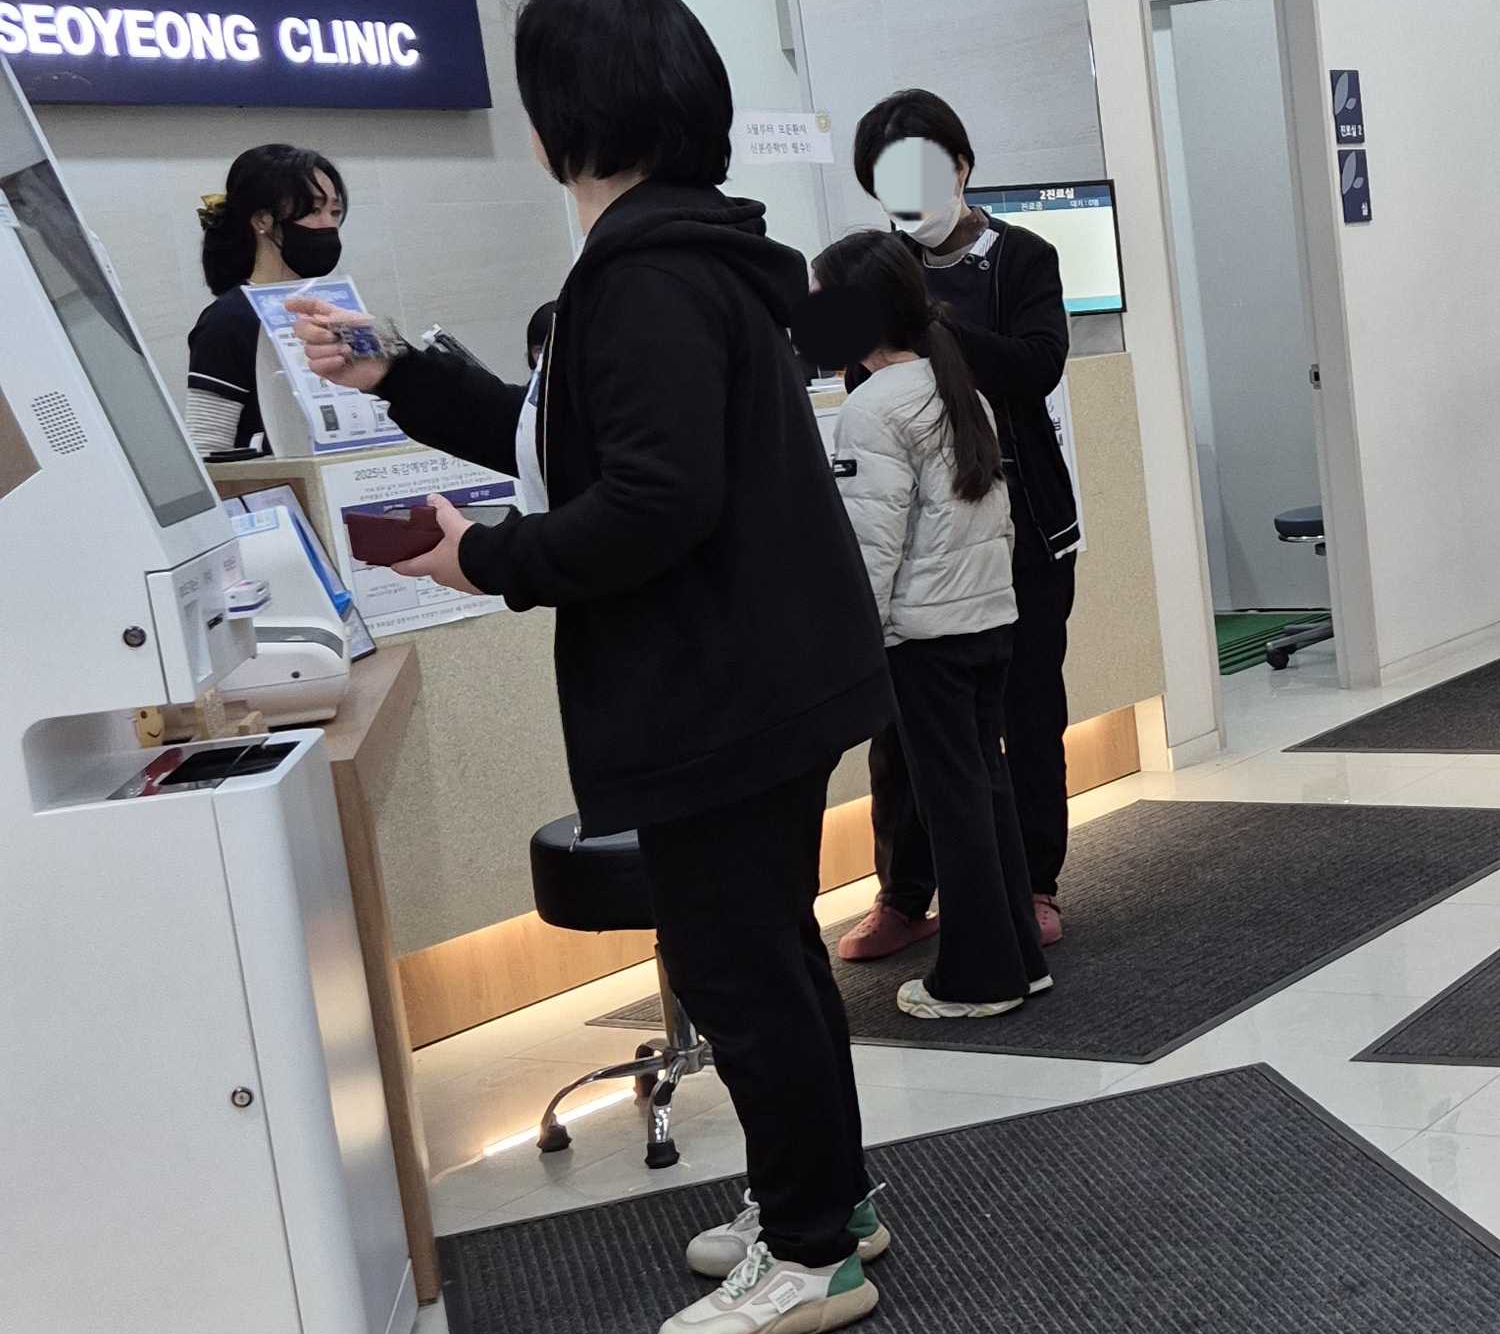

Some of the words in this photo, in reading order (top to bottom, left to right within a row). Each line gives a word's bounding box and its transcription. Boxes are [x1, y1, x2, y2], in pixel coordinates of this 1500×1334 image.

[0, 0, 260, 62] SEOYEONG
[279, 17, 421, 67] CLINIC
[1340, 124, 1357, 138] 진료실
[1039, 187, 1075, 201] 2진료실
[354, 467, 388, 481] 2025년
[391, 457, 449, 476] 독감예방접종
